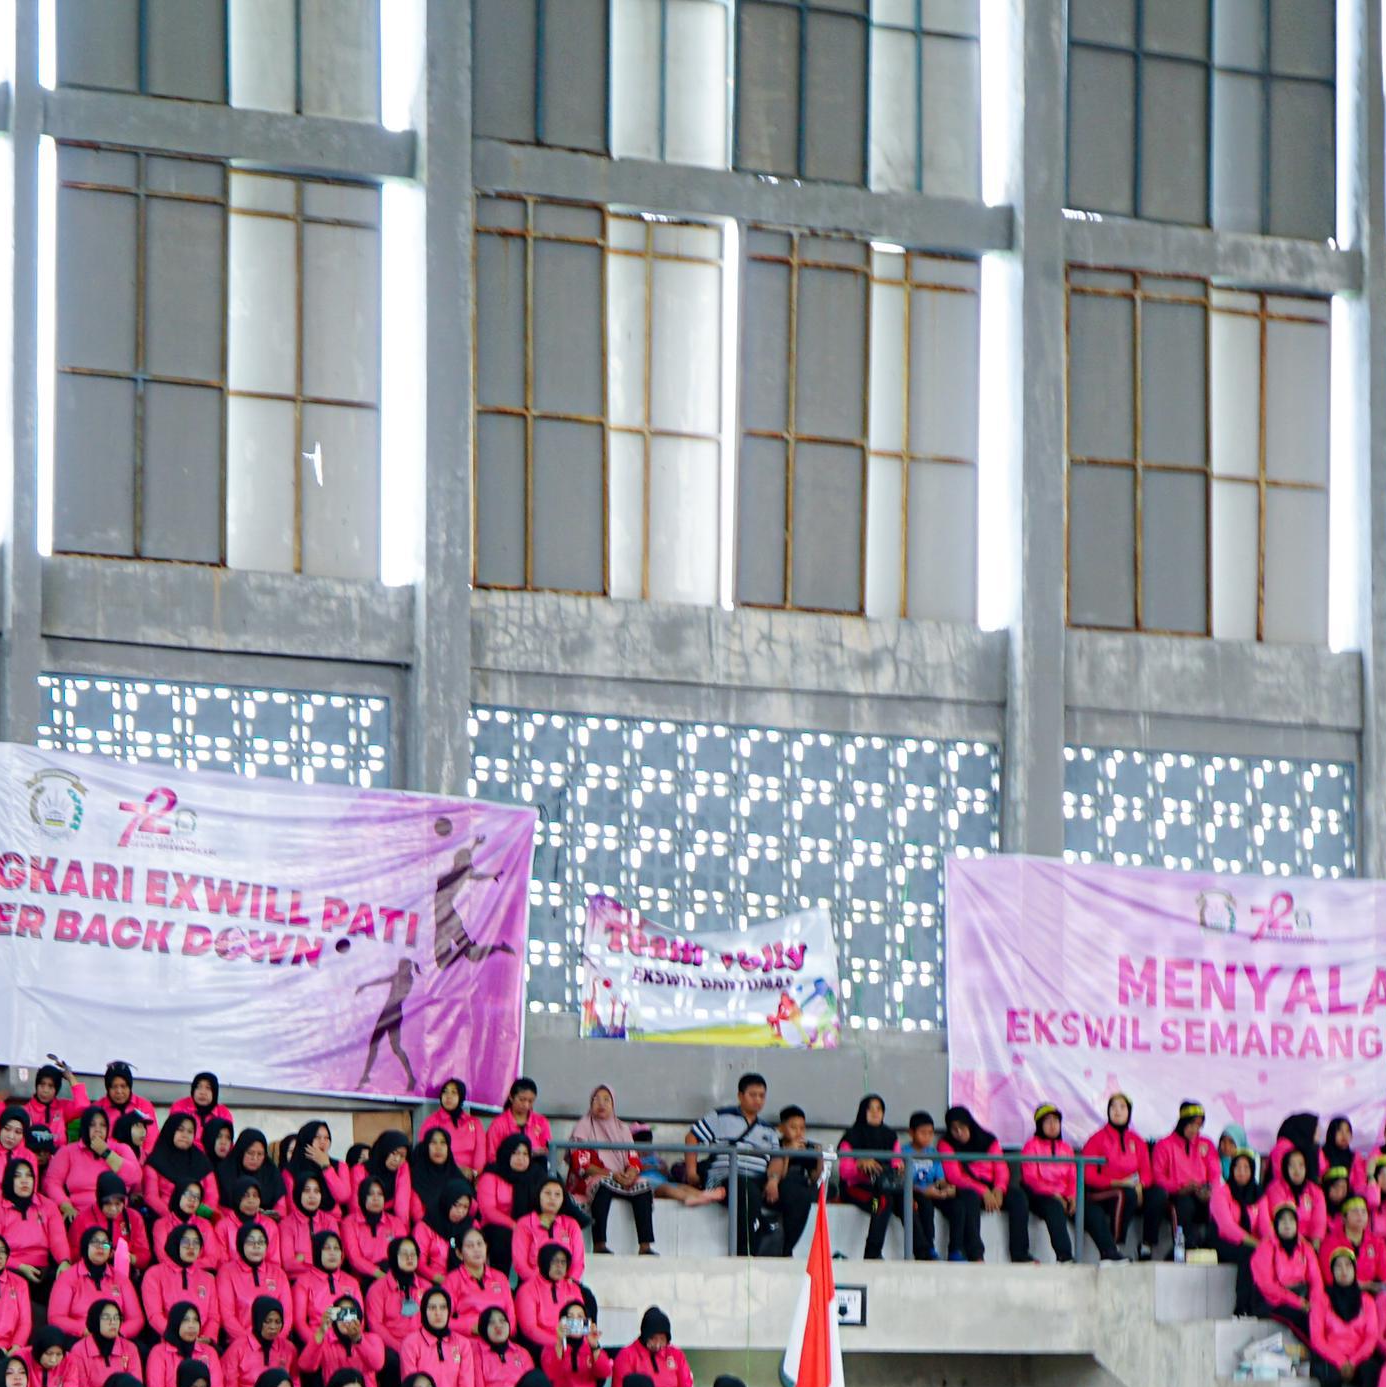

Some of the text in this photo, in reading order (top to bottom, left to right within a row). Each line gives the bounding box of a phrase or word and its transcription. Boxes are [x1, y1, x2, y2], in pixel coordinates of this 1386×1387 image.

[118, 786, 178, 848] 72
[145, 869, 311, 928] EXWILL
[321, 896, 420, 947] PATI
[1249, 890, 1295, 943] 72
[53, 910, 175, 954] BACK
[181, 922, 326, 969] DOWN
[1005, 1007, 1154, 1054] EKSWIL
